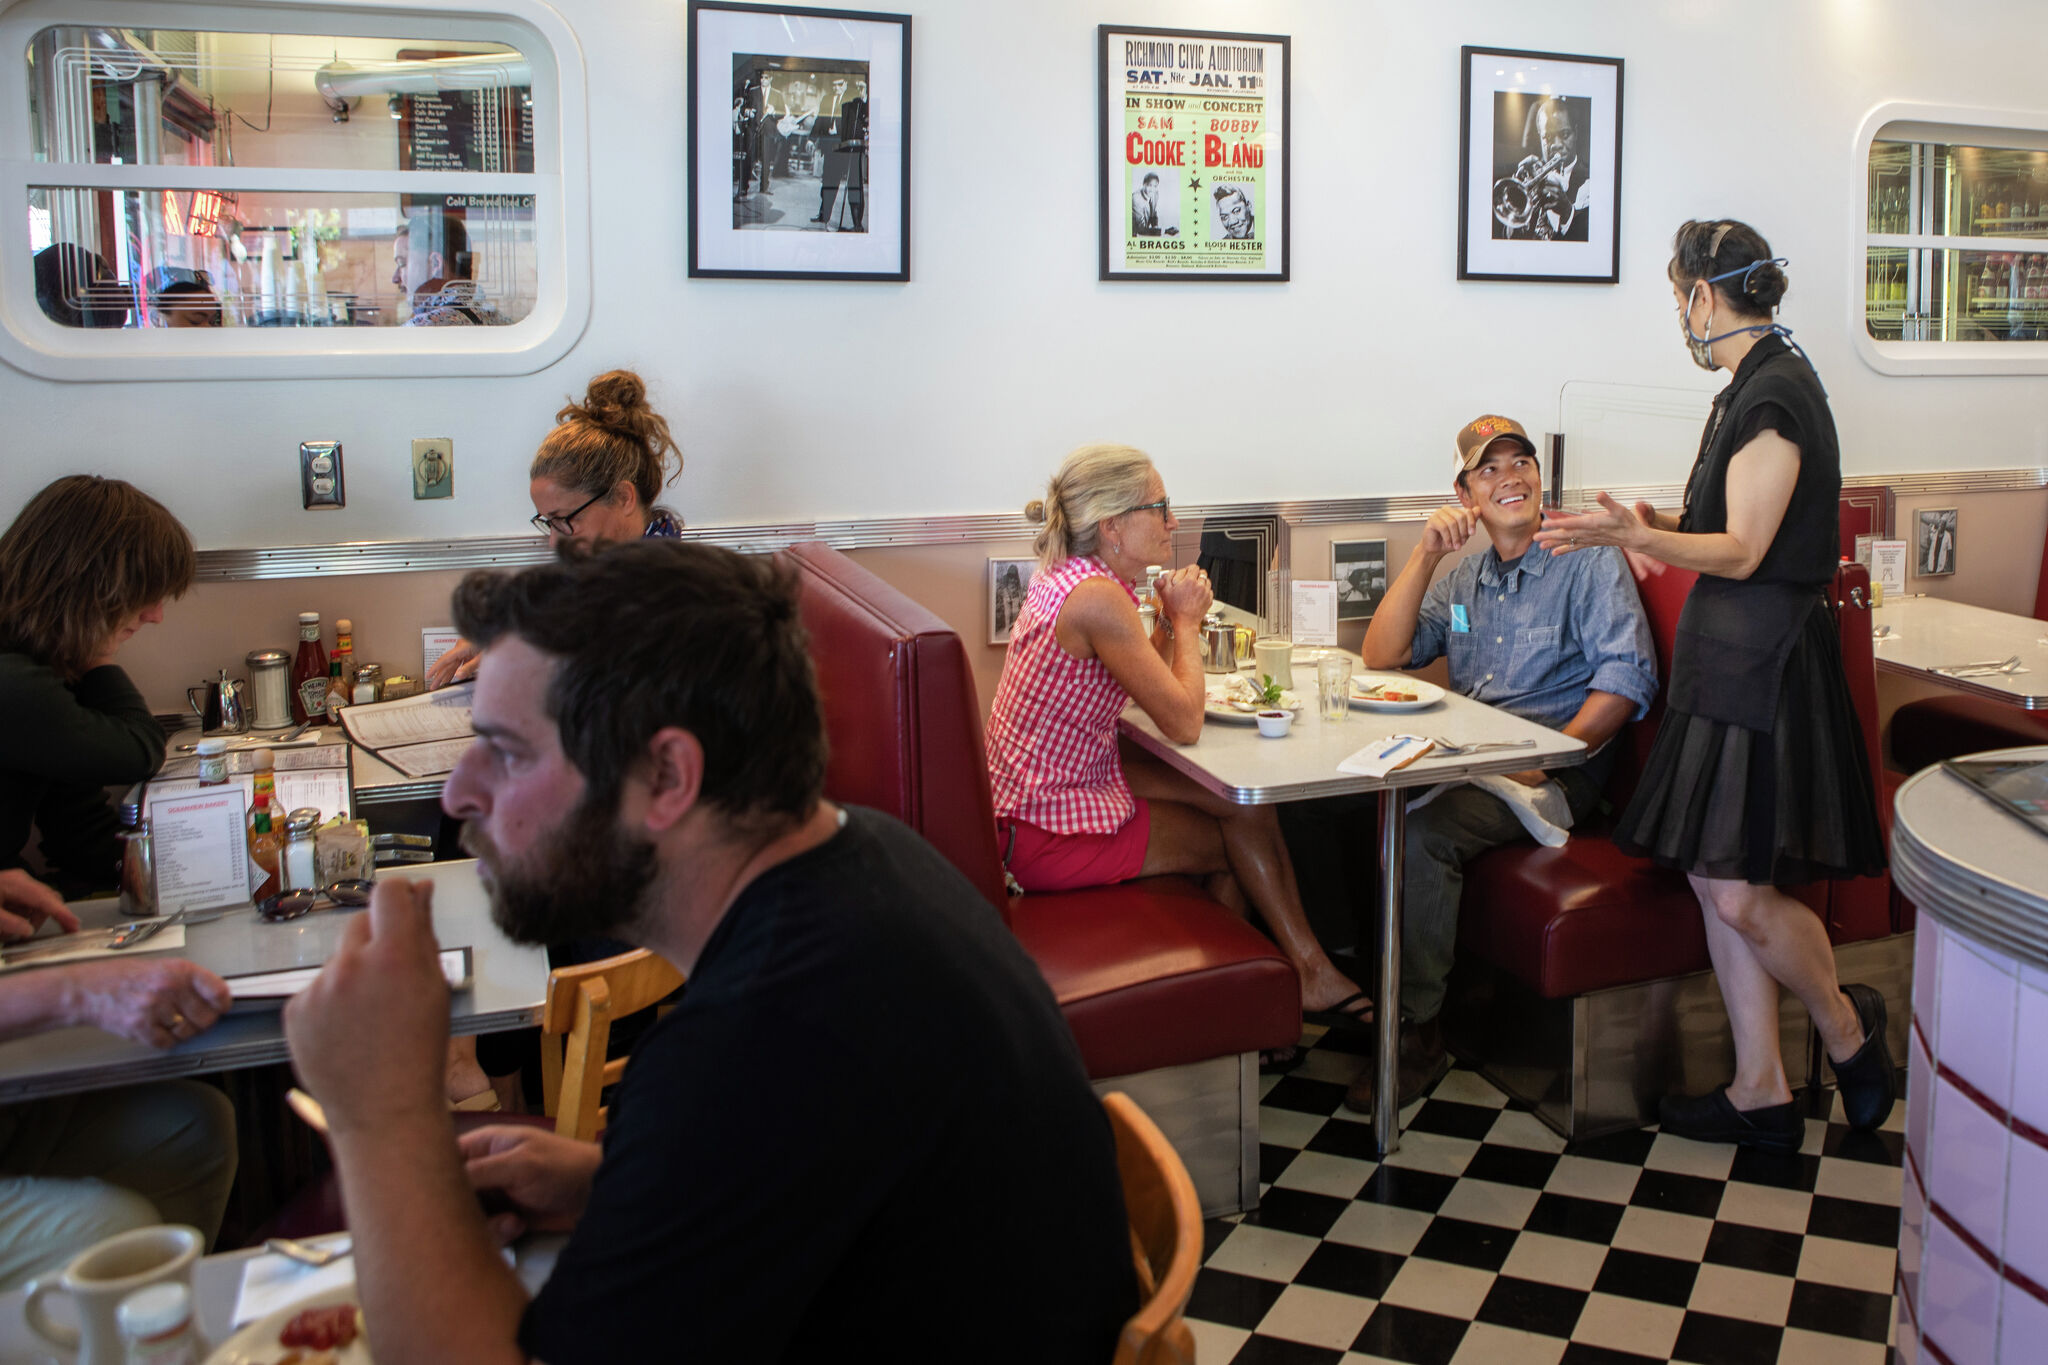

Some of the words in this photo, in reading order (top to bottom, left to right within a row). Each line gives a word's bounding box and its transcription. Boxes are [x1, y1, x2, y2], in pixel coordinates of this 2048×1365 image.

[1125, 41, 1174, 68] RICHMOND
[1179, 44, 1204, 71] CIVIC
[1208, 46, 1264, 73] AUDITORIUM
[1126, 70, 1168, 84] SAT.
[1170, 72, 1186, 84] Nite
[1189, 73, 1233, 88] JAN.
[1126, 97, 1140, 108] IN
[1145, 99, 1186, 110] SHOW
[1203, 101, 1264, 113] CONCERT
[1137, 116, 1174, 130] SAM
[1210, 119, 1260, 133] BOBBY
[1212, 175, 1256, 183] ORCHESTRA
[446, 196, 466, 207] Cold
[469, 196, 500, 207] Brewed
[1139, 241, 1186, 250] BRAGGS
[1229, 242, 1263, 251] HESTER
